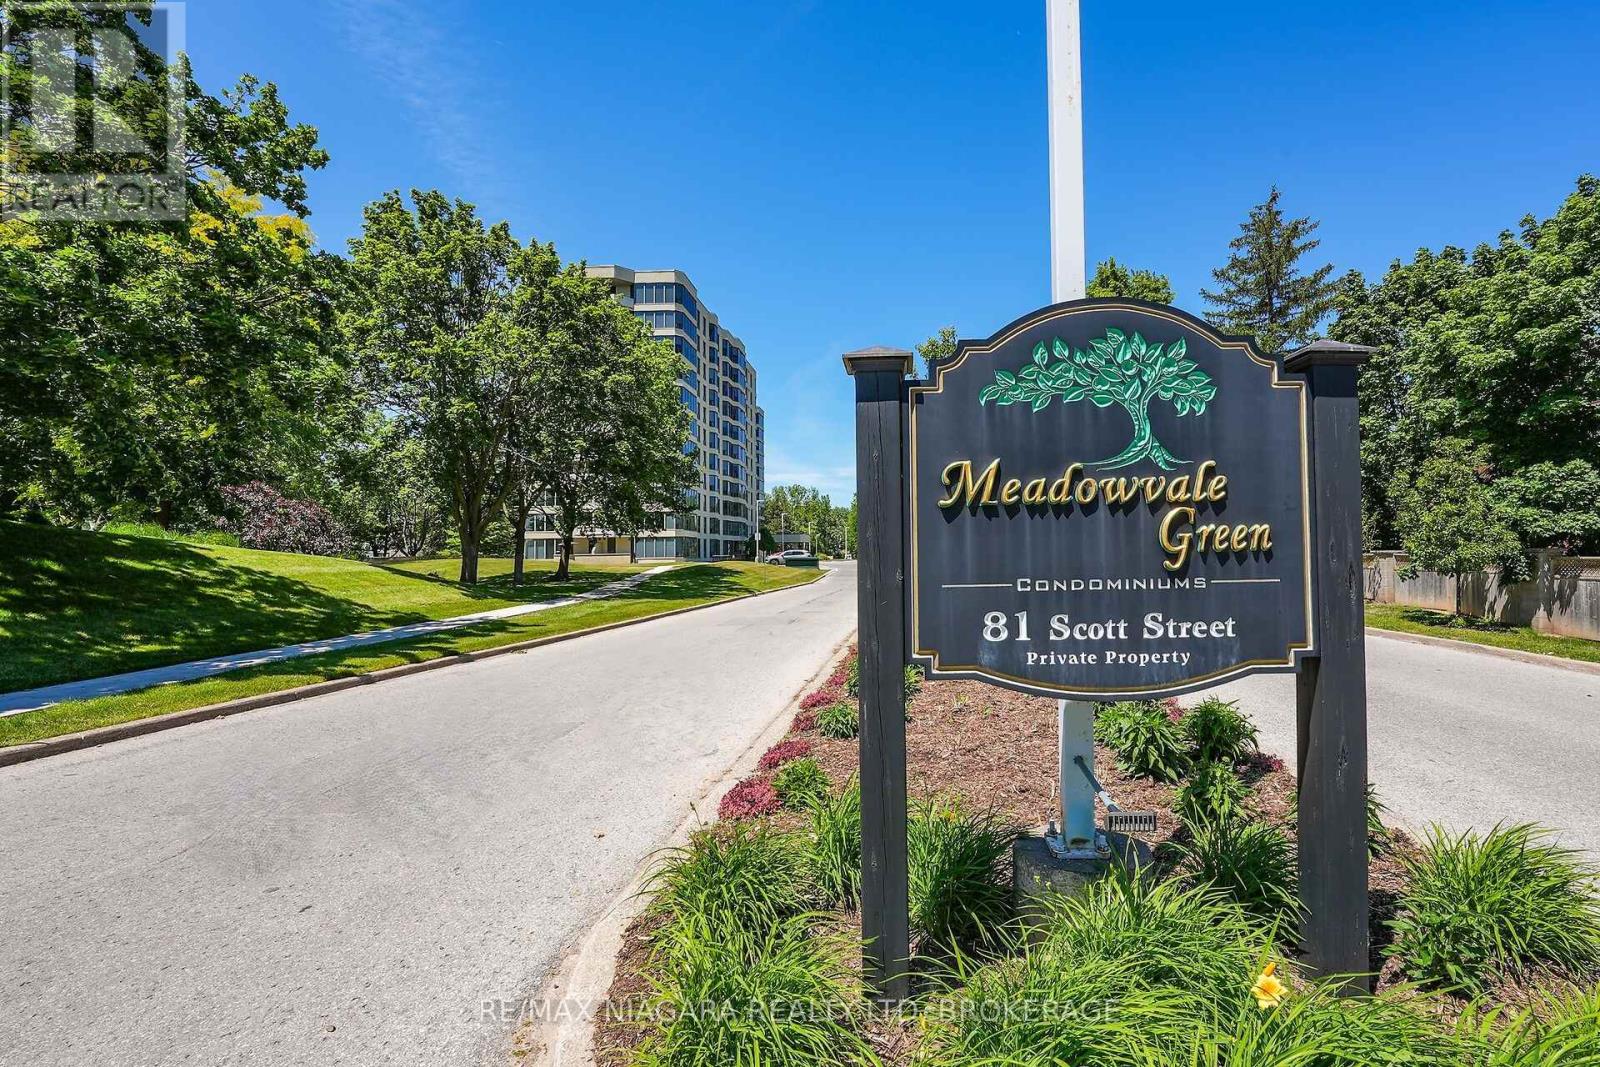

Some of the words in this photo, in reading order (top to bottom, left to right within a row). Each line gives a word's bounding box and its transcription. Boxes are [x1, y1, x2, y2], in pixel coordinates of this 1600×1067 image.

[934, 457, 1229, 509] Meadowvale
[1158, 506, 1273, 572] Green
[1016, 577, 1207, 592] CONDOMINIUMS
[982, 610, 1032, 642] 81
[1049, 614, 1128, 641] Scott
[1143, 612, 1237, 640] Street
[1026, 651, 1097, 665] Private
[1104, 650, 1191, 667] Property
